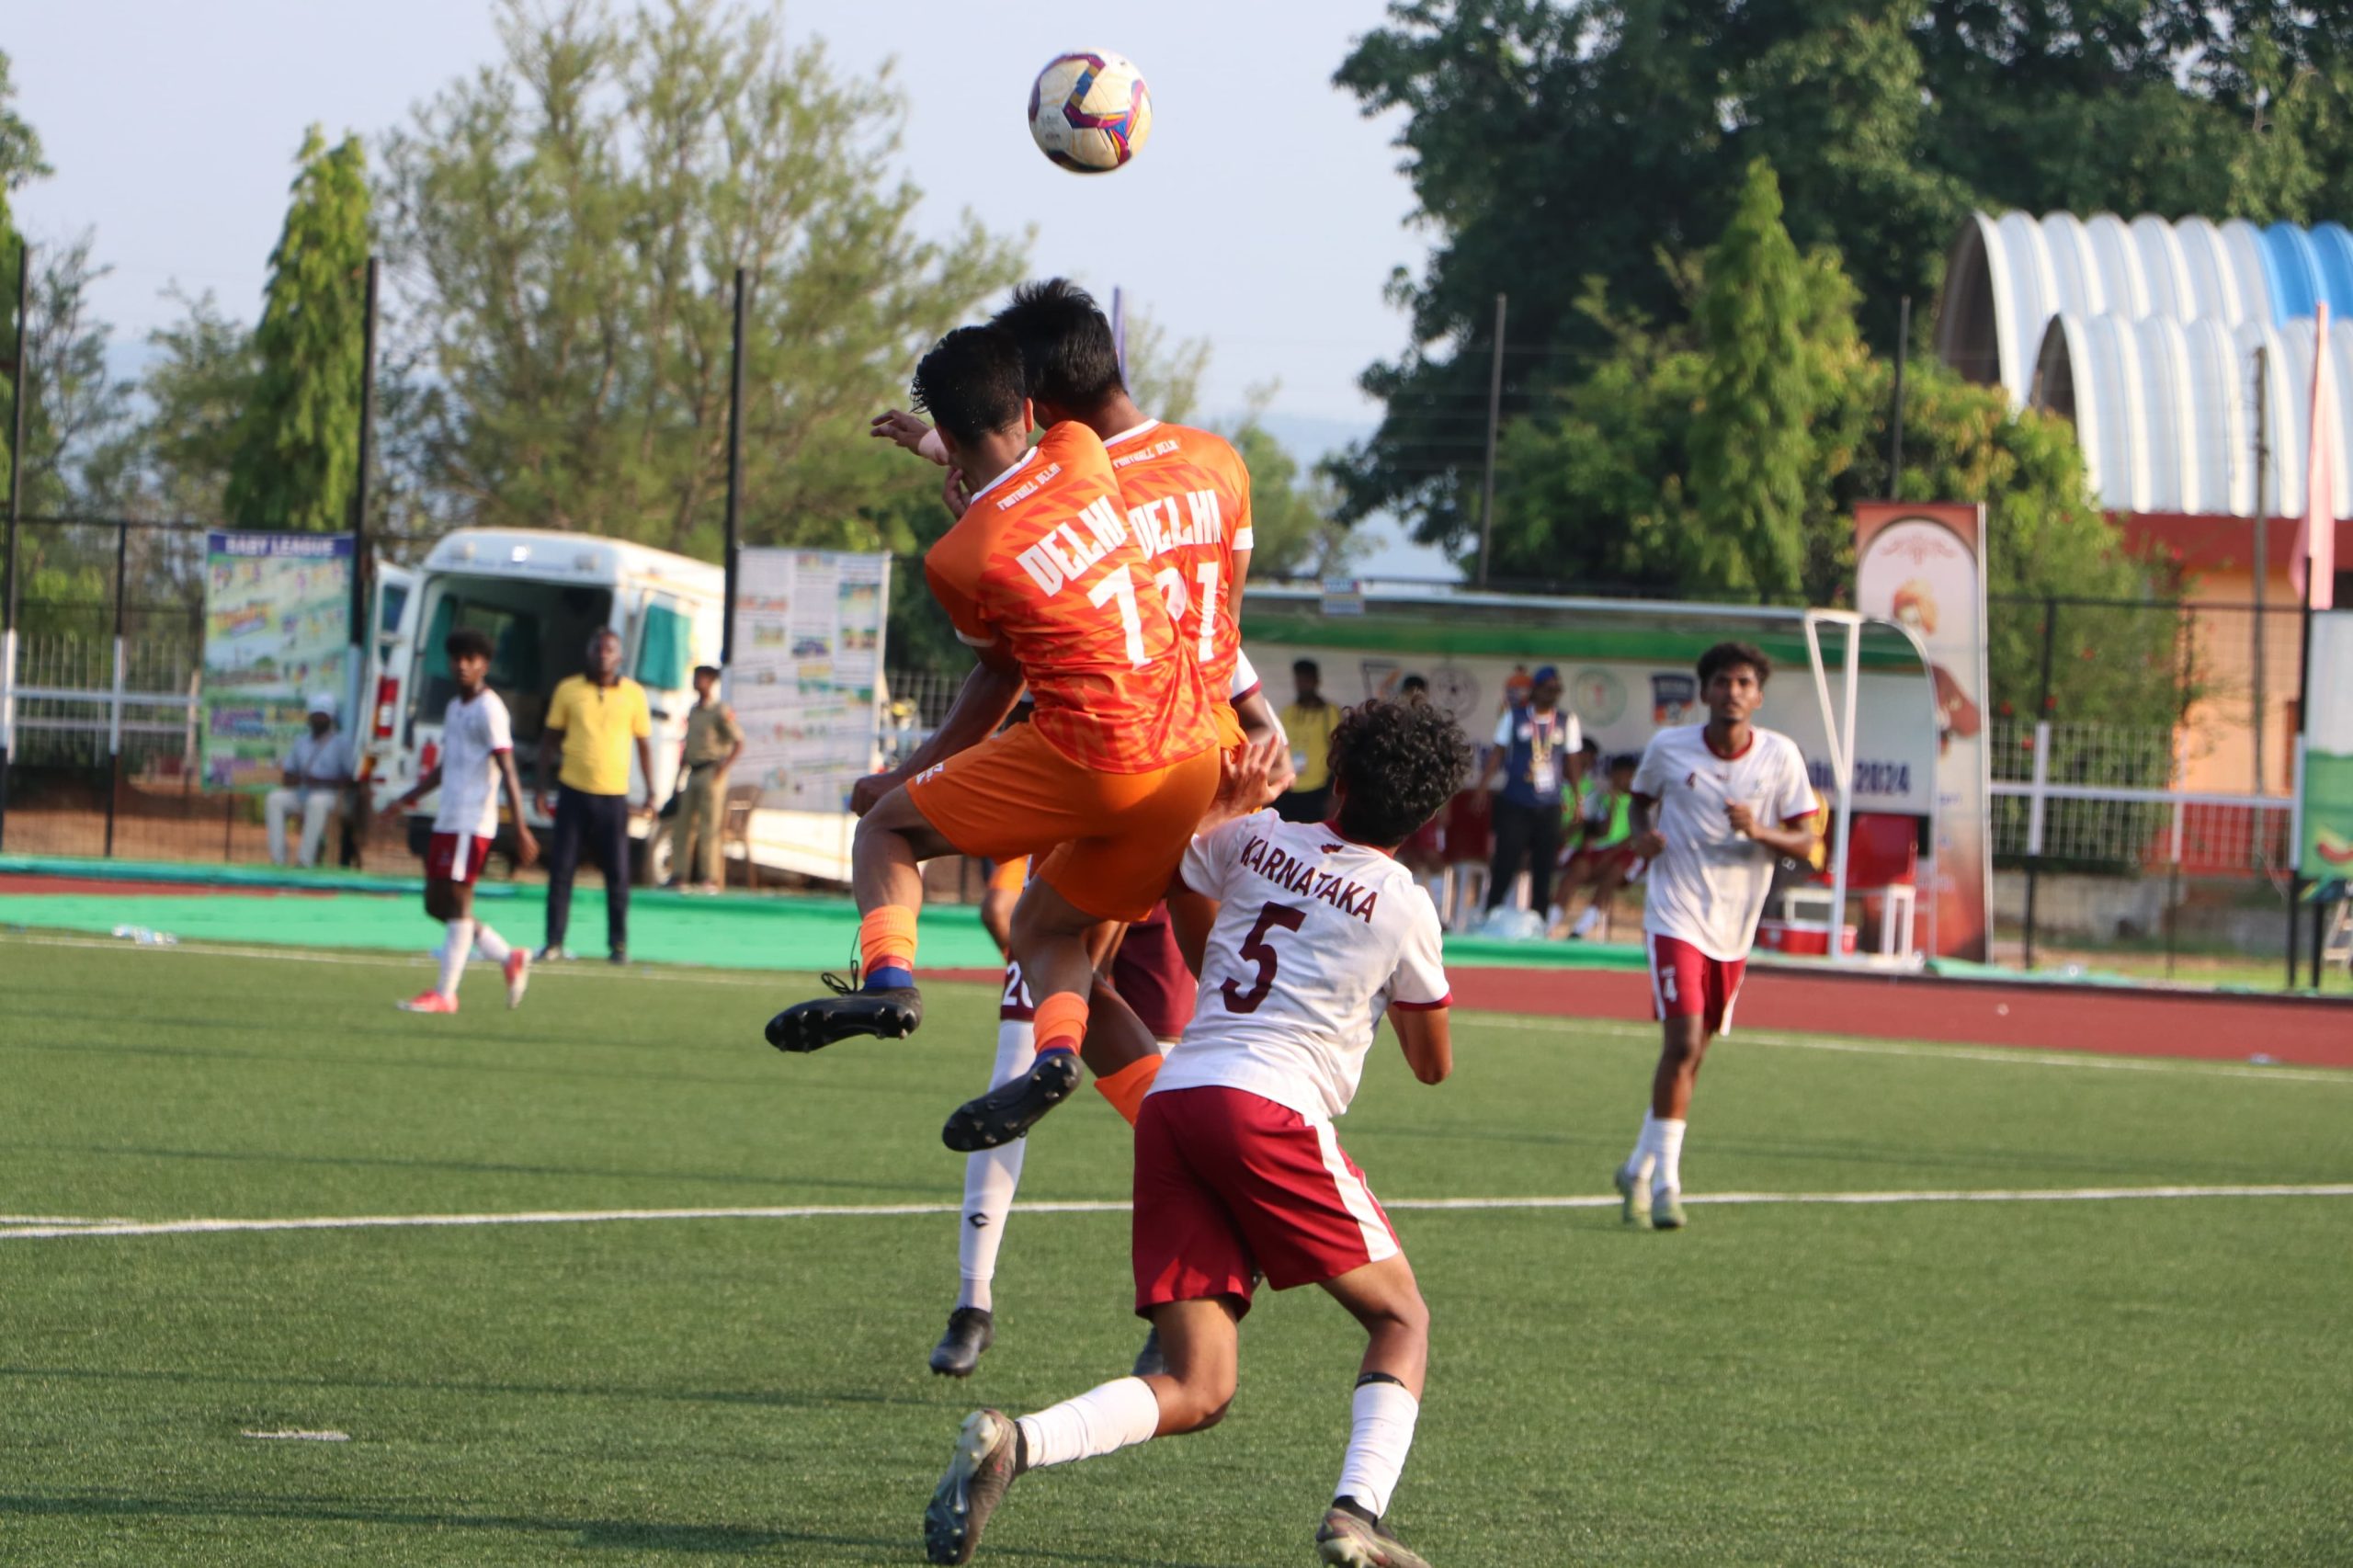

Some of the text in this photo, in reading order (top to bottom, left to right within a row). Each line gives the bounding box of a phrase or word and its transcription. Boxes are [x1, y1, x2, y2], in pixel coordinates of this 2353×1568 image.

[1035, 462, 1062, 485] DELHI
[1015, 494, 1128, 597] DELHI
[1127, 489, 1222, 561] DELHI
[1086, 562, 1152, 670] 7
[1855, 761, 1912, 795] 2024
[1241, 835, 1378, 924] KARNATAKA
[1220, 901, 1307, 1015] 5
